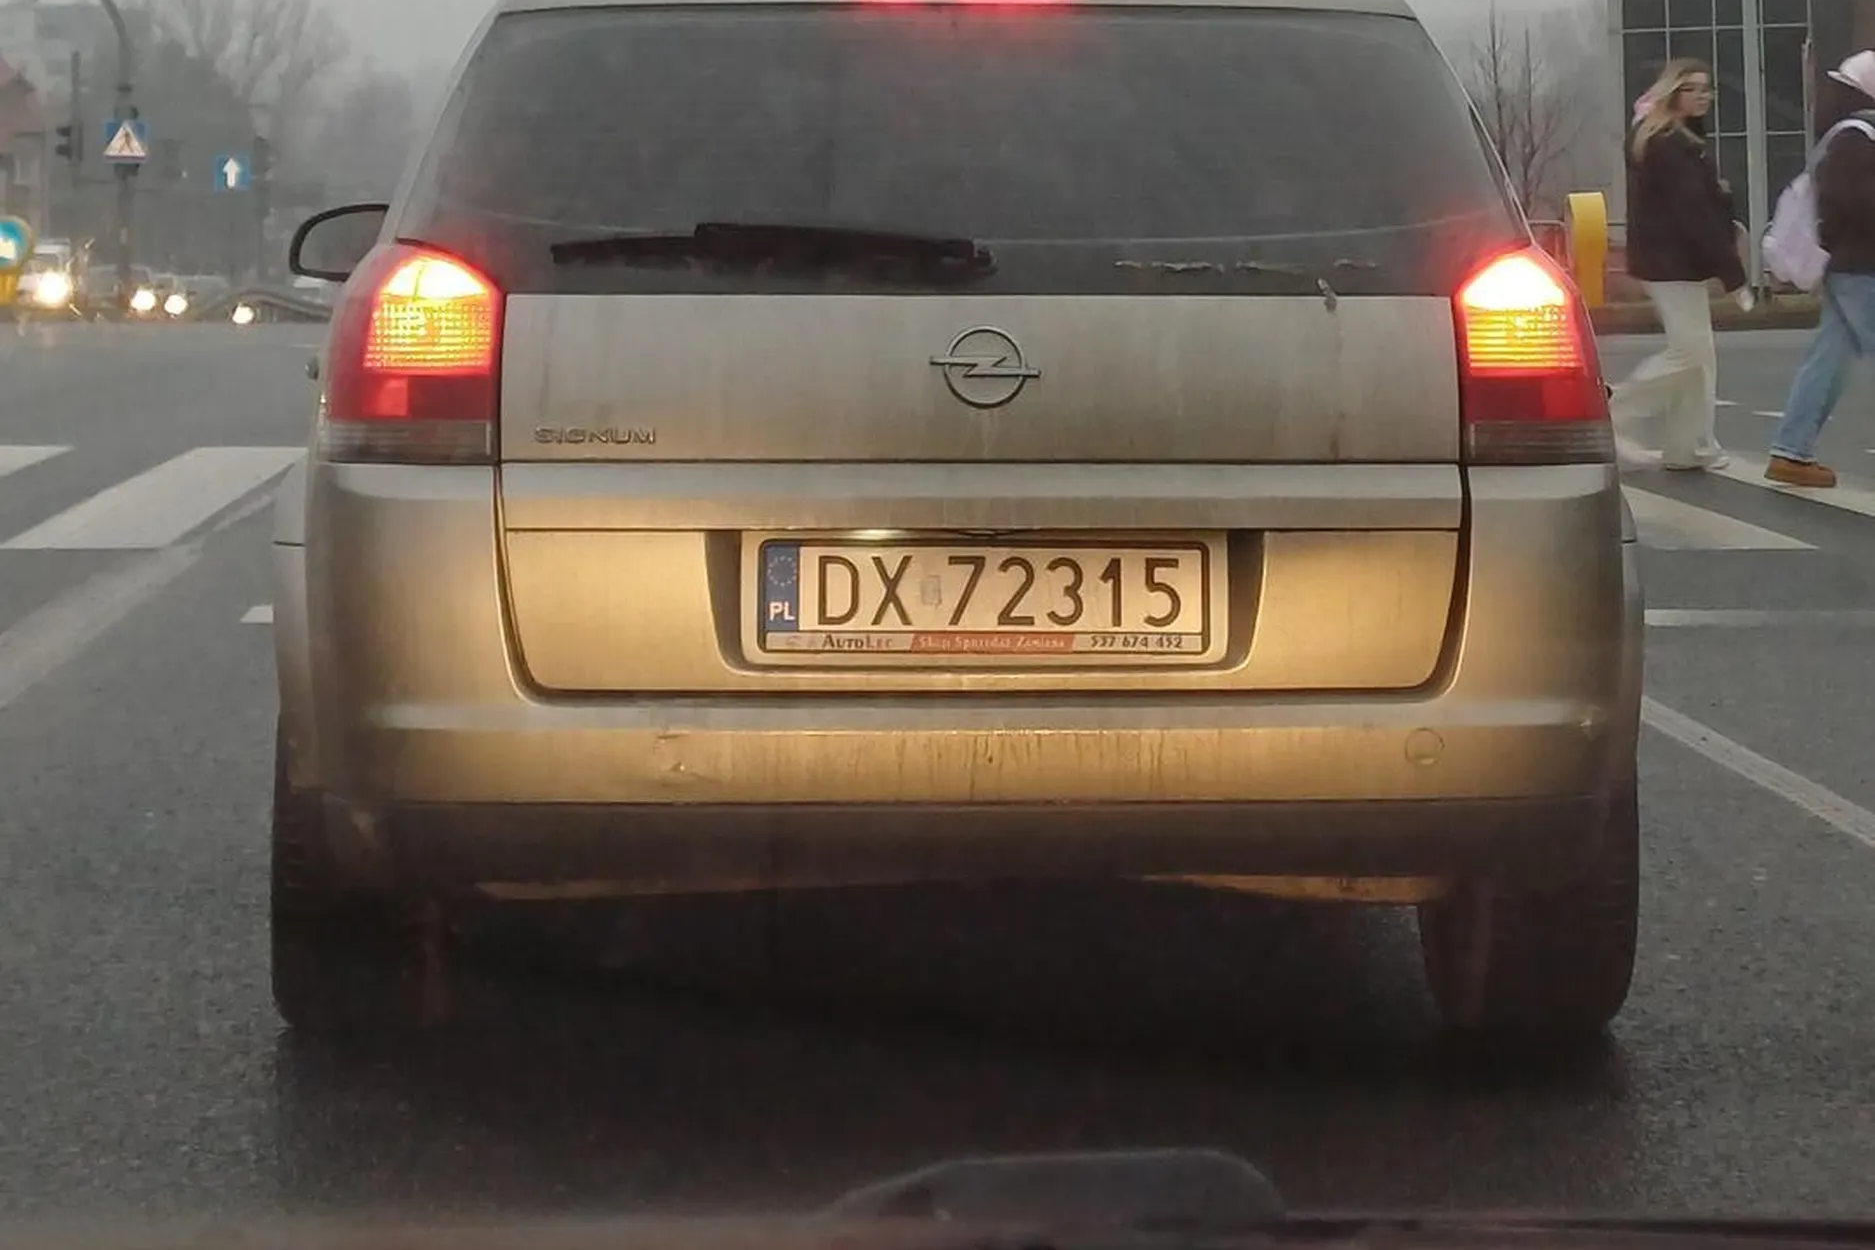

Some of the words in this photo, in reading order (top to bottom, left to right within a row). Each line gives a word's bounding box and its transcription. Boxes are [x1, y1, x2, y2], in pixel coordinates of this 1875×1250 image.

[534, 426, 657, 445] SIGNUM
[817, 555, 913, 626] DX
[947, 556, 1182, 628] 72315
[768, 601, 796, 621] PL
